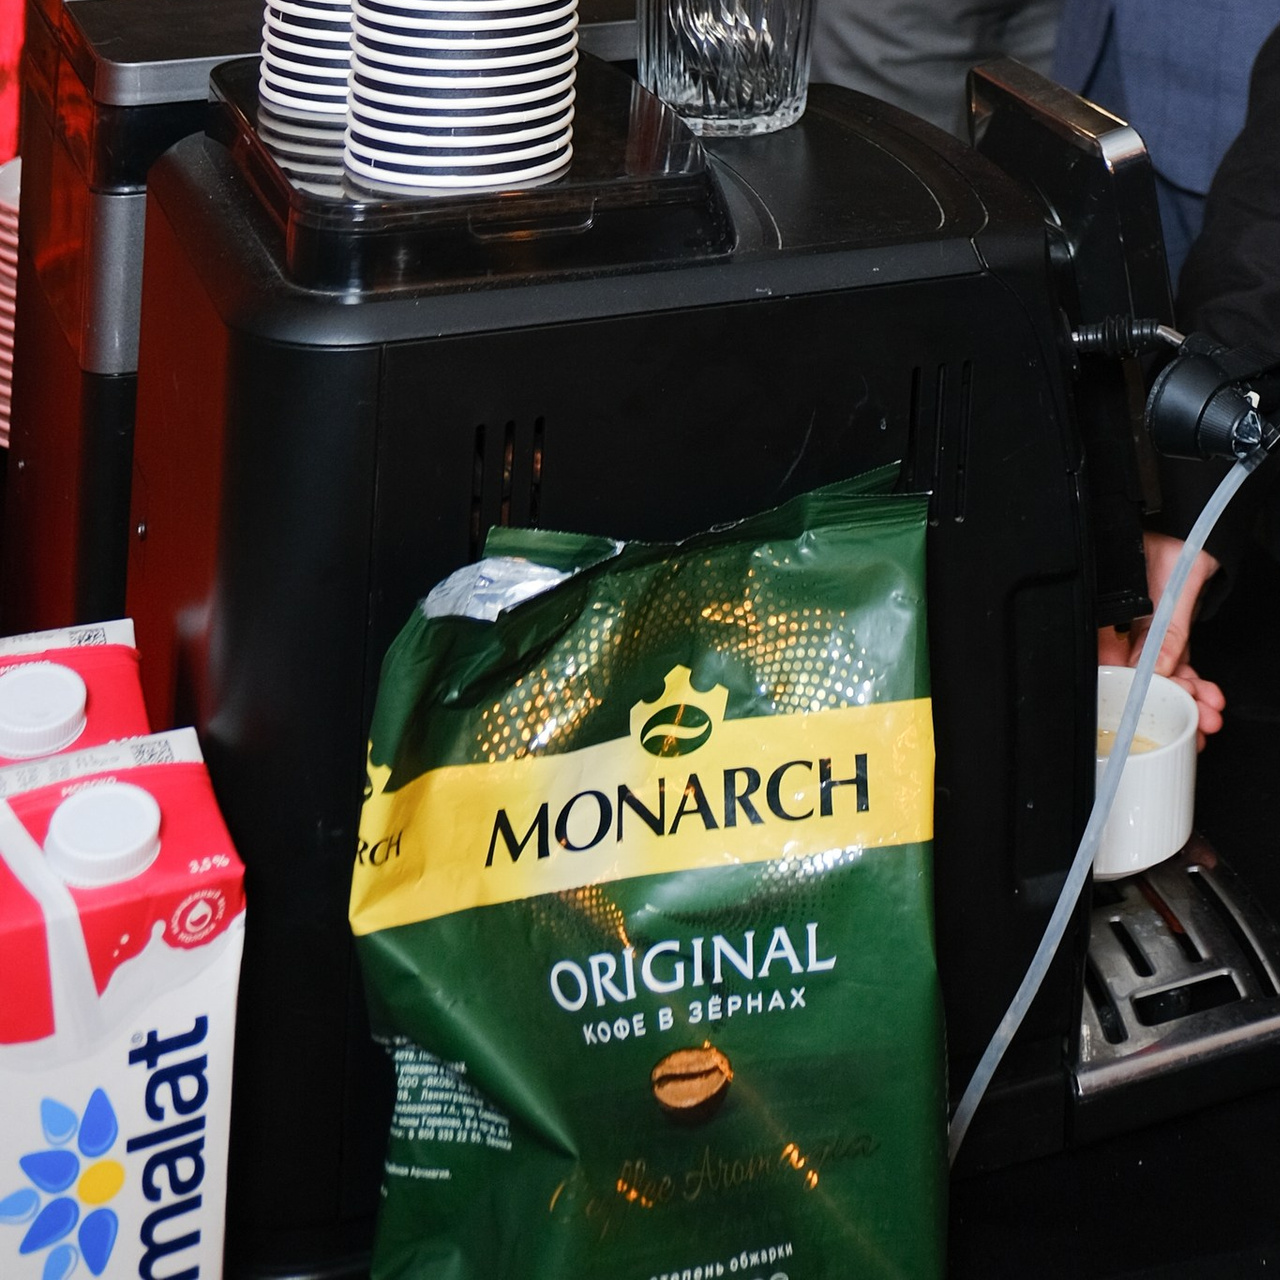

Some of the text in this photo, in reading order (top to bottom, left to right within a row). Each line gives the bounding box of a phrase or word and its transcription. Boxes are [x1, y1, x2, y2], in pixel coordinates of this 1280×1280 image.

[485, 753, 870, 868] MONARCH
[550, 922, 837, 1012] ORIGINAL
[582, 986, 807, 1045] КОФЕ В ЗЁРНАХ
[729, 1241, 794, 1273] обжарки
